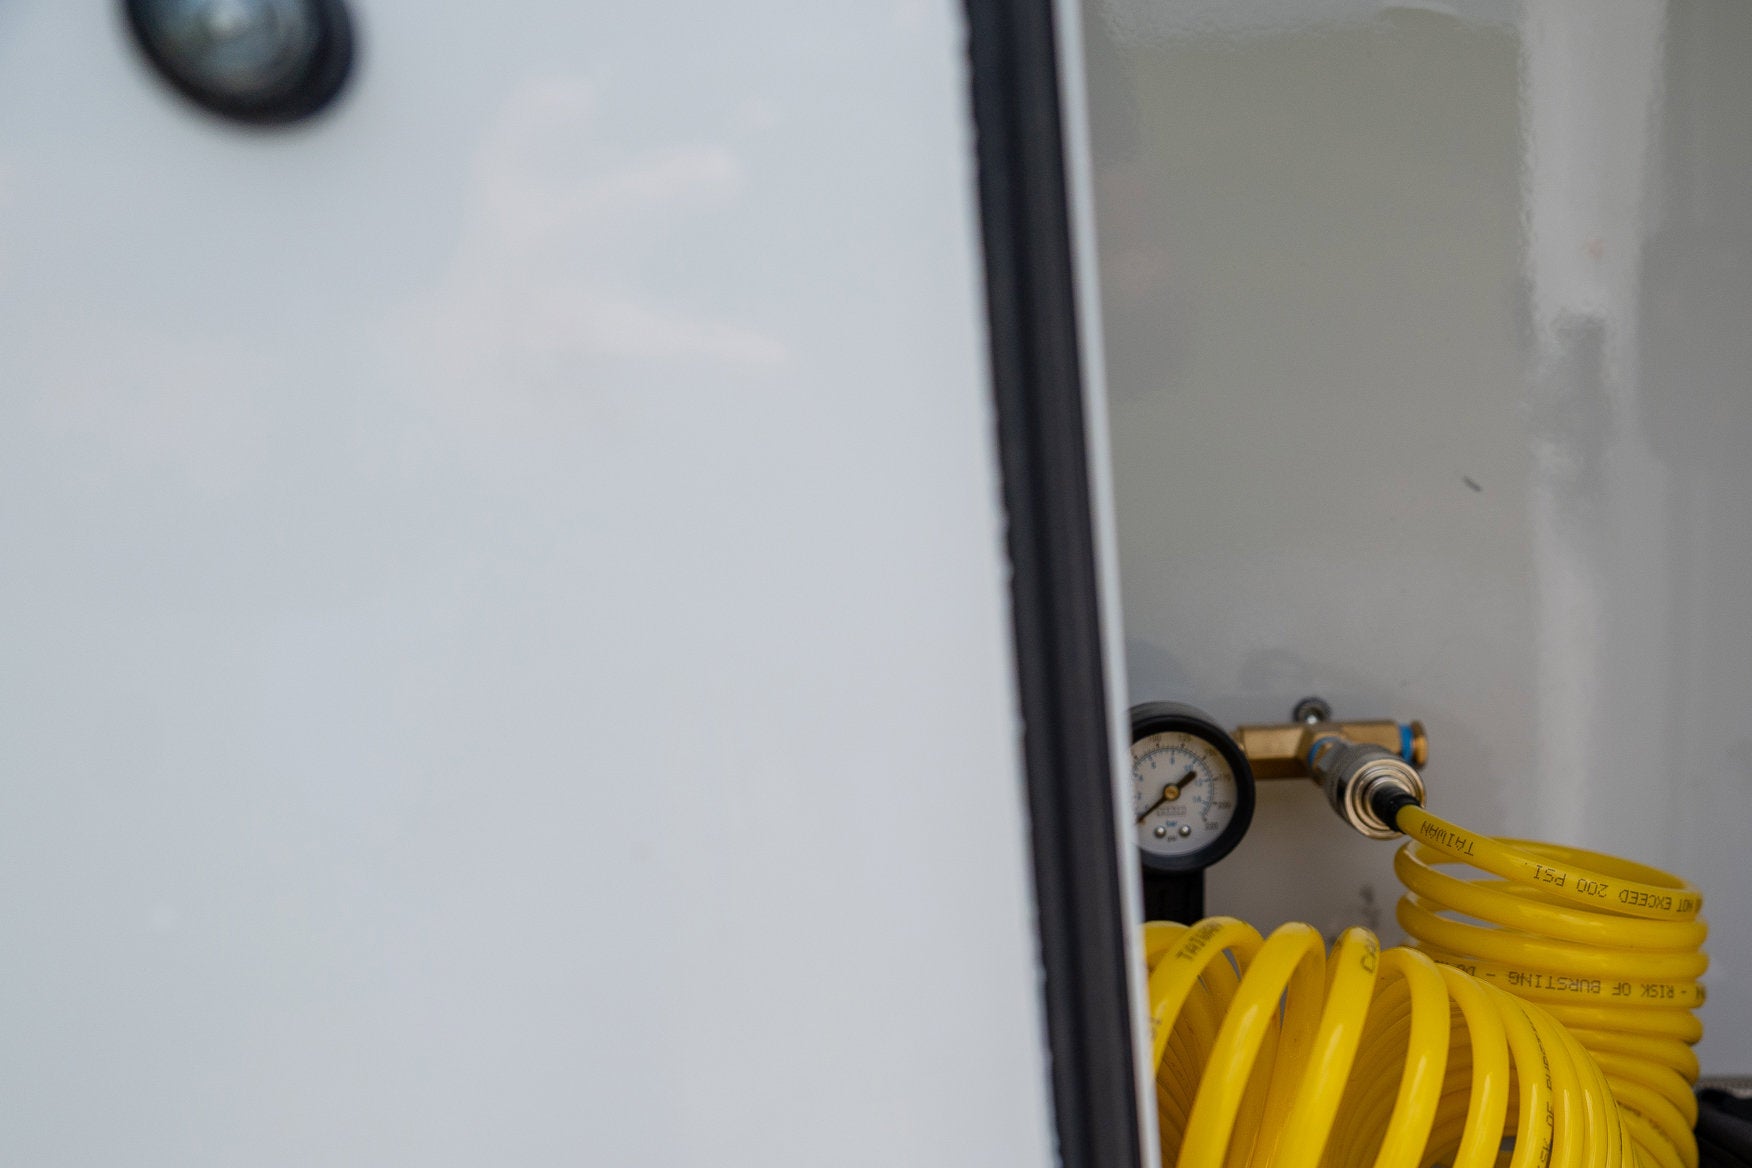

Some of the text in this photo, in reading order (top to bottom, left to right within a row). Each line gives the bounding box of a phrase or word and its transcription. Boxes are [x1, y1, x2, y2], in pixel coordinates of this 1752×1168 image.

[1420, 820, 1475, 857] TAIWAN
[1576, 878, 1609, 898] 200
[1618, 889, 1673, 911] EXCEED
[1507, 971, 1601, 994] BURSTING
[1611, 982, 1632, 997] OF
[1640, 983, 1675, 999] RISK
